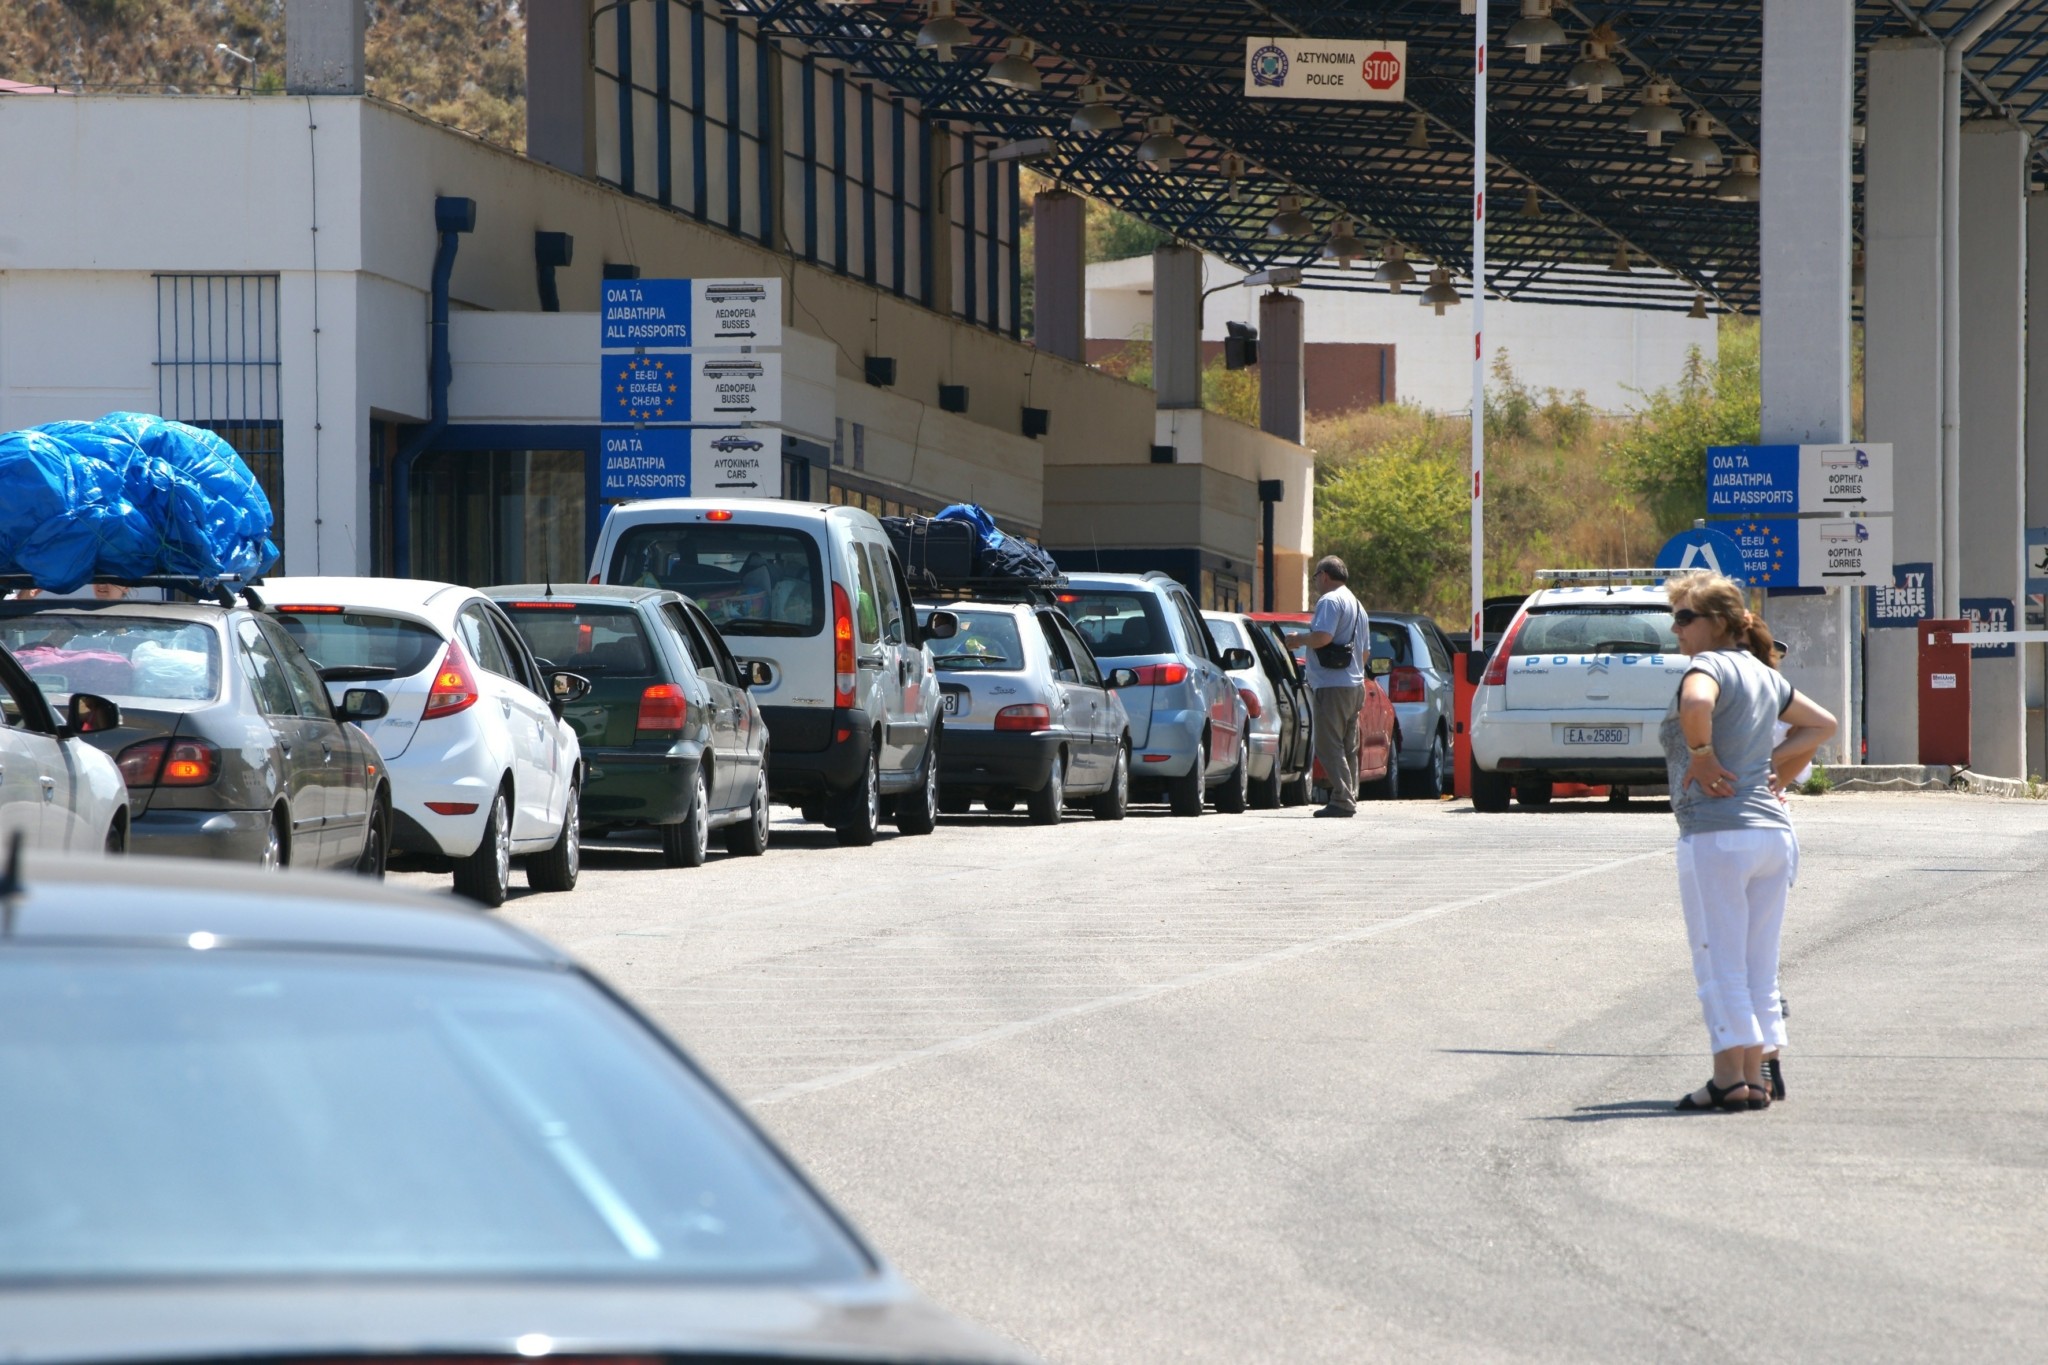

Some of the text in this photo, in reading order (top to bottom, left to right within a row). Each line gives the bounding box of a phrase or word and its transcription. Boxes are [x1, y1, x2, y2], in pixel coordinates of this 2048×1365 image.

[1296, 52, 1356, 65] ΑΣΤΥΝΟΜΙΑ
[1364, 60, 1399, 81] STOP
[1306, 74, 1344, 86] POLICE
[607, 289, 643, 302] ΟΛΑ ΤΑ
[607, 307, 666, 320] ΔΙΑΒΑΤΗΡΙΑ
[715, 309, 756, 319] ΛΕΩΦΟΡΕΙΑ
[722, 320, 750, 329] BUSSES
[607, 324, 687, 338] ALL PASSPORTS
[715, 384, 756, 393] ΛΕΩΦΟΡΕΙΑ
[721, 394, 750, 404] BUSSES
[607, 439, 643, 452] ΟΛΑ ΤΑ
[606, 457, 665, 470] ΔΙΑΒΑΤΗΡΙΑ
[714, 459, 759, 468] ΑΥΤΟΚΙΝΗΤΑ
[1713, 456, 1749, 468] ΟΛΑ ΤΑ
[606, 474, 686, 488] ALL PASSPORTS
[727, 470, 747, 480] CARS
[1713, 473, 1773, 486] ΔΙΑΒΑΤΗΡΙΑ
[1828, 474, 1863, 484] ΦΟΡΤΗΓΑ
[1829, 485, 1861, 494] LORRIES
[1712, 490, 1794, 504] ALL PASSPORTS
[1827, 548, 1863, 558] ΦΟΡΤΗΓΑ
[1829, 559, 1861, 568] LORRIES
[1885, 587, 1926, 605] FREE
[1886, 605, 1926, 618] SHOPS
[1525, 656, 1665, 666] POLICE
[1593, 729, 1623, 743] 25850
